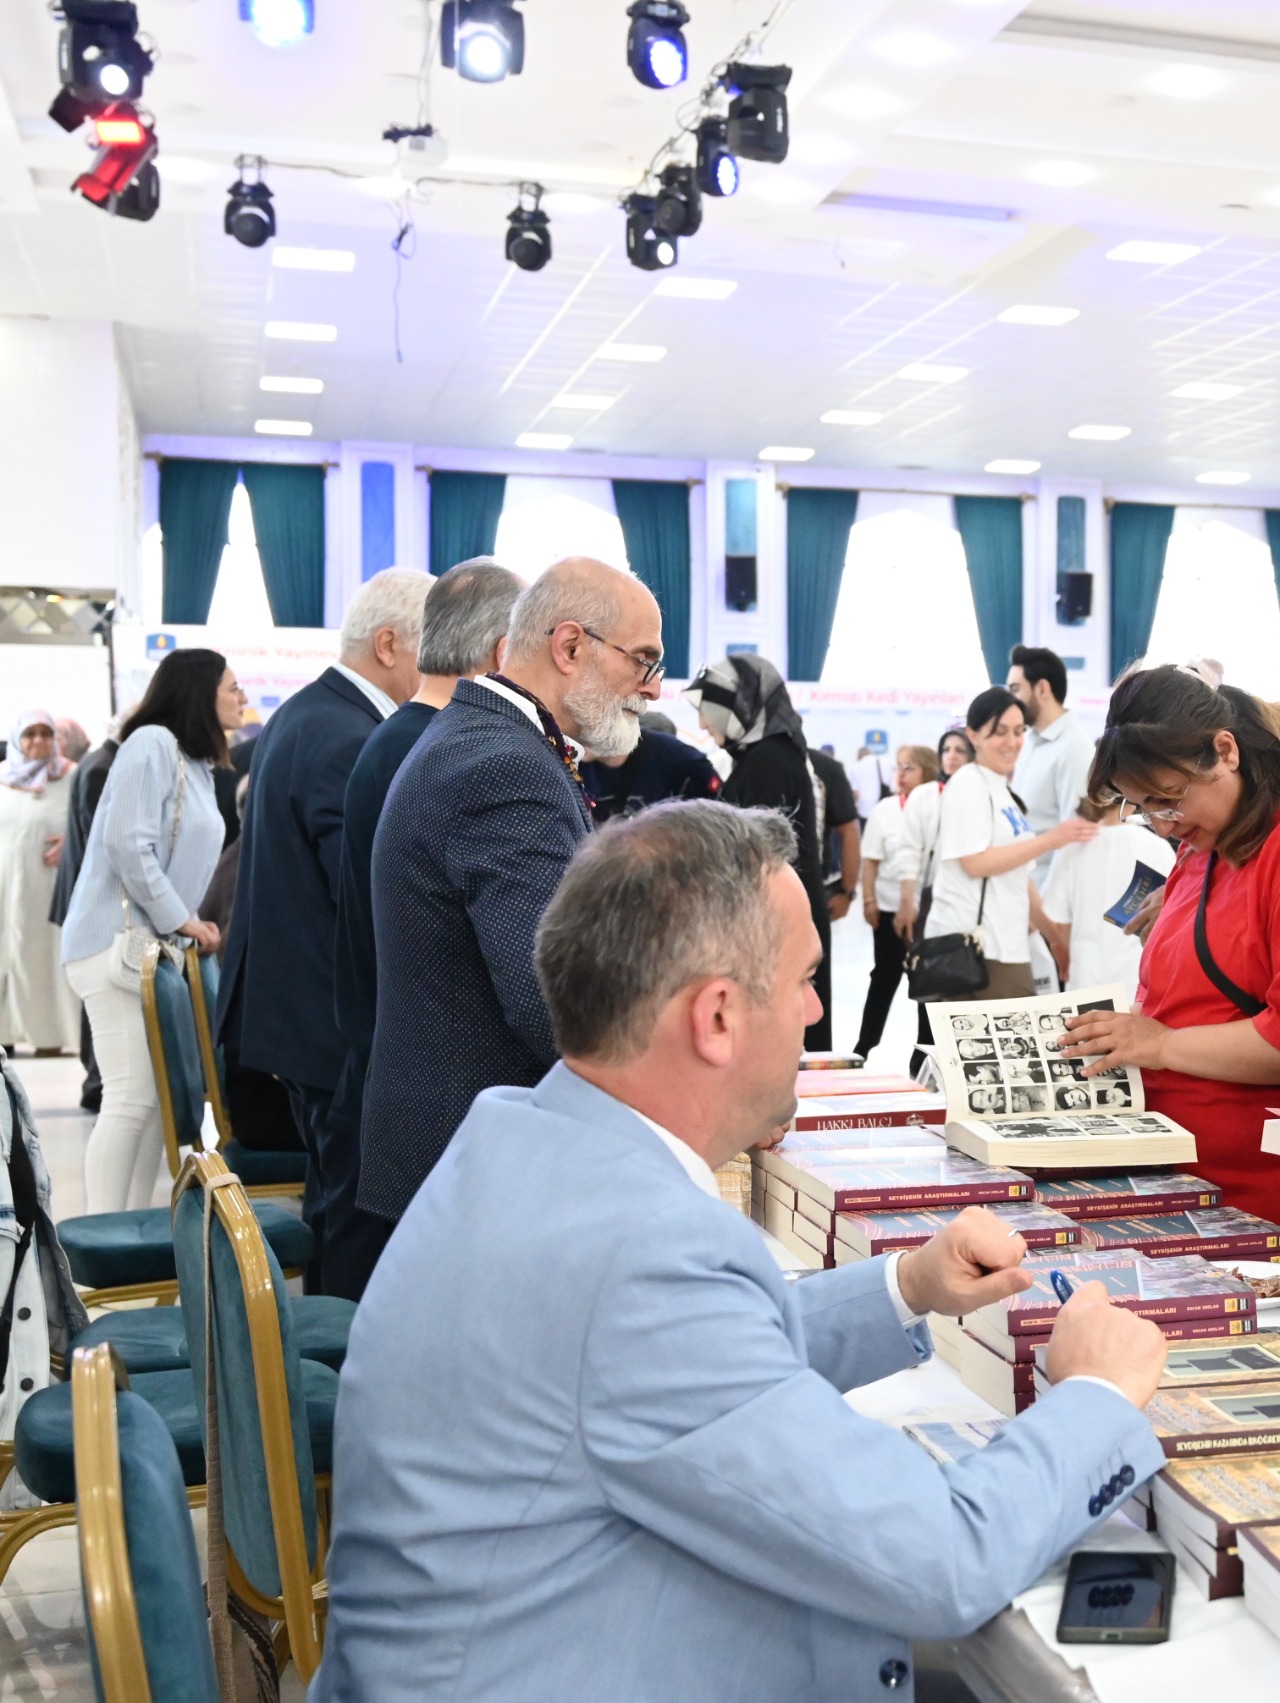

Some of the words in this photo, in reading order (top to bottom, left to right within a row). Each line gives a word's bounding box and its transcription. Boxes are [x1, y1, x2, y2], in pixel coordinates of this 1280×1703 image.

[888, 1193, 922, 1202] SEYDİŞEHİR
[924, 1191, 971, 1200] ARAŞTIRMALARI
[1120, 1201, 1164, 1210] ARAŞTIRMALARI
[1150, 1247, 1183, 1255] SEYDİŞEHİR
[1184, 1243, 1230, 1252] ARAŞTIRMALARI
